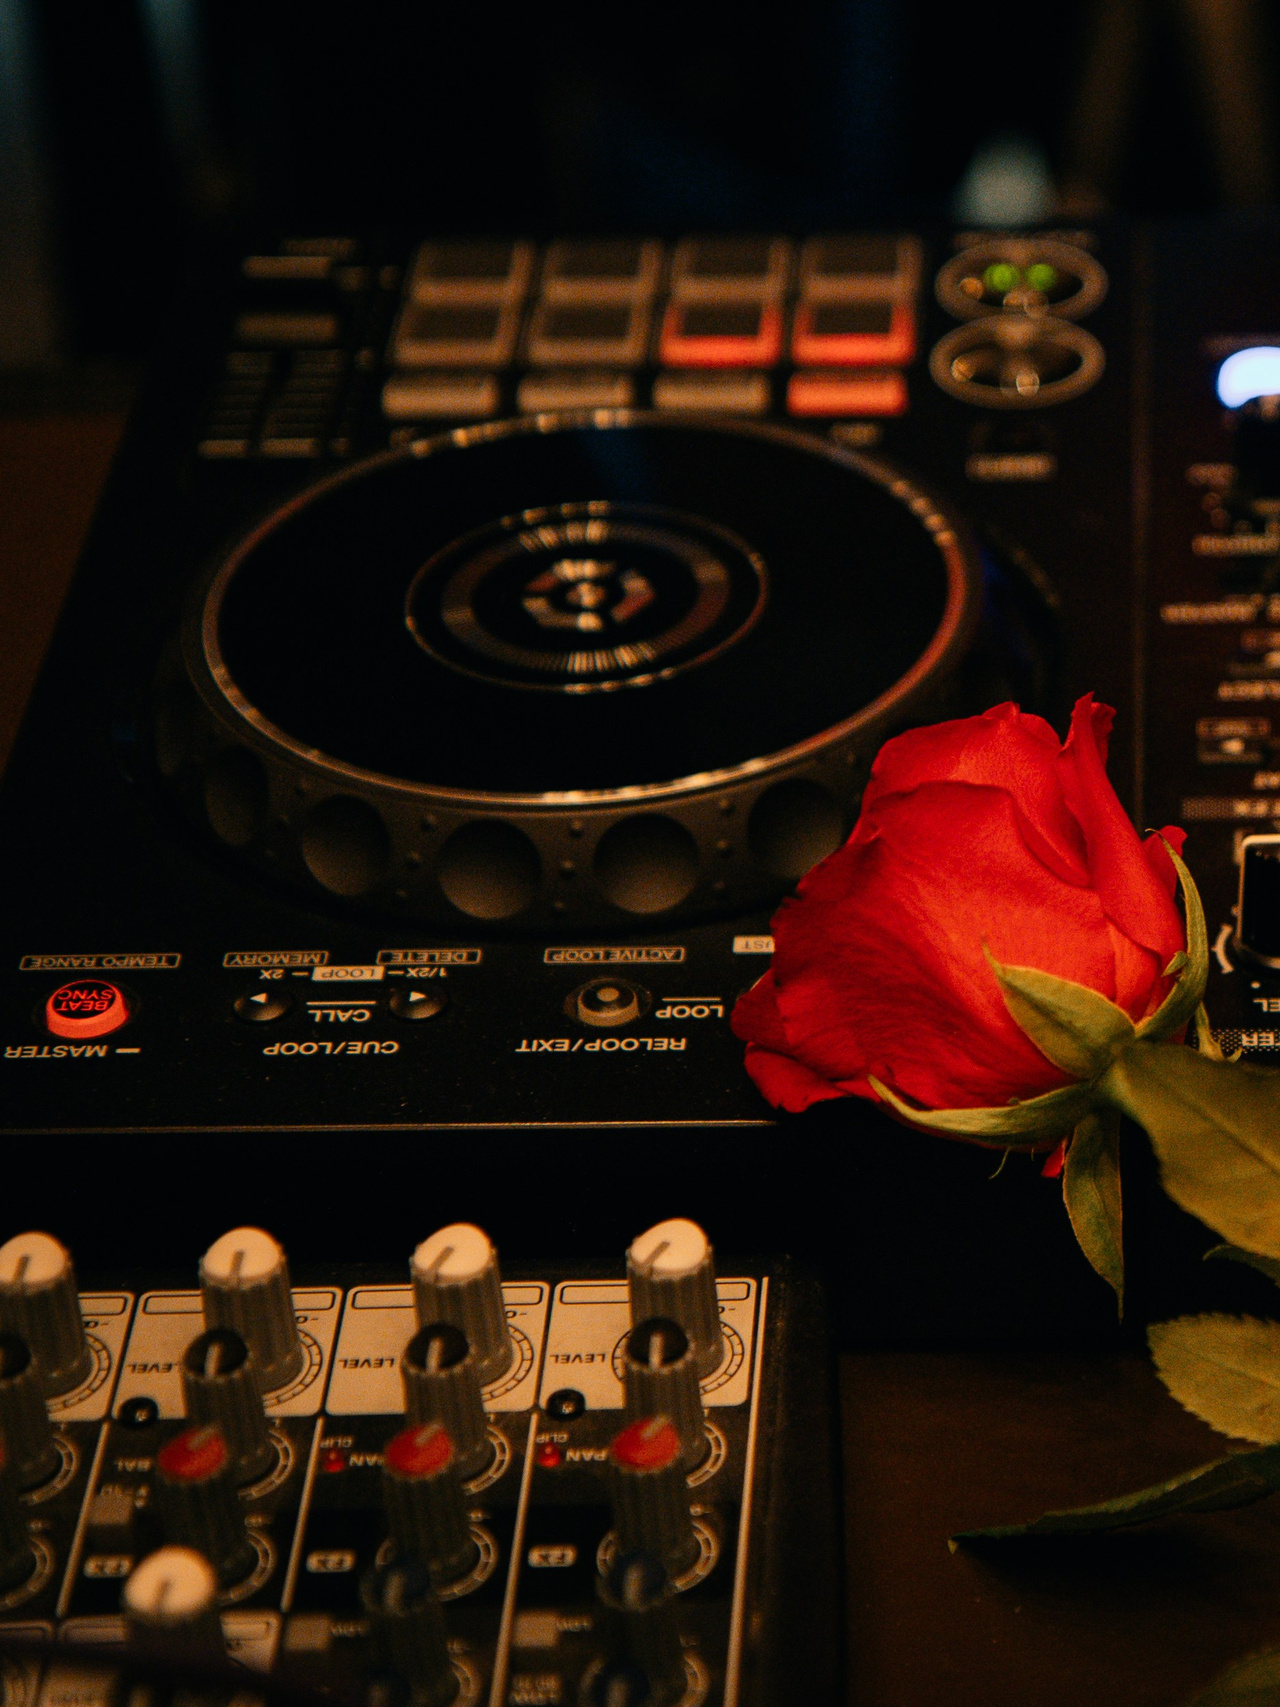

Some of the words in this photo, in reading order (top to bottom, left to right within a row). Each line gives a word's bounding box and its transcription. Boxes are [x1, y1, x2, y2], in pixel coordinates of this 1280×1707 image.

[103, 955, 169, 968] TEMPO
[230, 952, 320, 966] MEMORY
[392, 950, 467, 964] DELETE
[553, 949, 603, 962] LOOP
[610, 949, 675, 962] ACTIVE
[31, 956, 97, 969] RANGE
[259, 968, 285, 980] 2X
[321, 968, 376, 980] LOOP
[405, 967, 448, 979] 1/2X
[57, 988, 114, 1001] SYNC
[57, 1000, 109, 1012] BEAT
[655, 1004, 724, 1018] LOOP
[307, 1009, 372, 1023] CALL
[262, 1041, 400, 1055] CUE/LOOP
[515, 1037, 687, 1052] RELOOP/EXIT
[4, 1044, 109, 1059] MASTER
[338, 1357, 395, 1369] LEVEL
[550, 1353, 605, 1364] LEVEL
[321, 1435, 353, 1448] CLIP
[536, 1431, 569, 1443] CLIP
[566, 1448, 608, 1461] PAN
